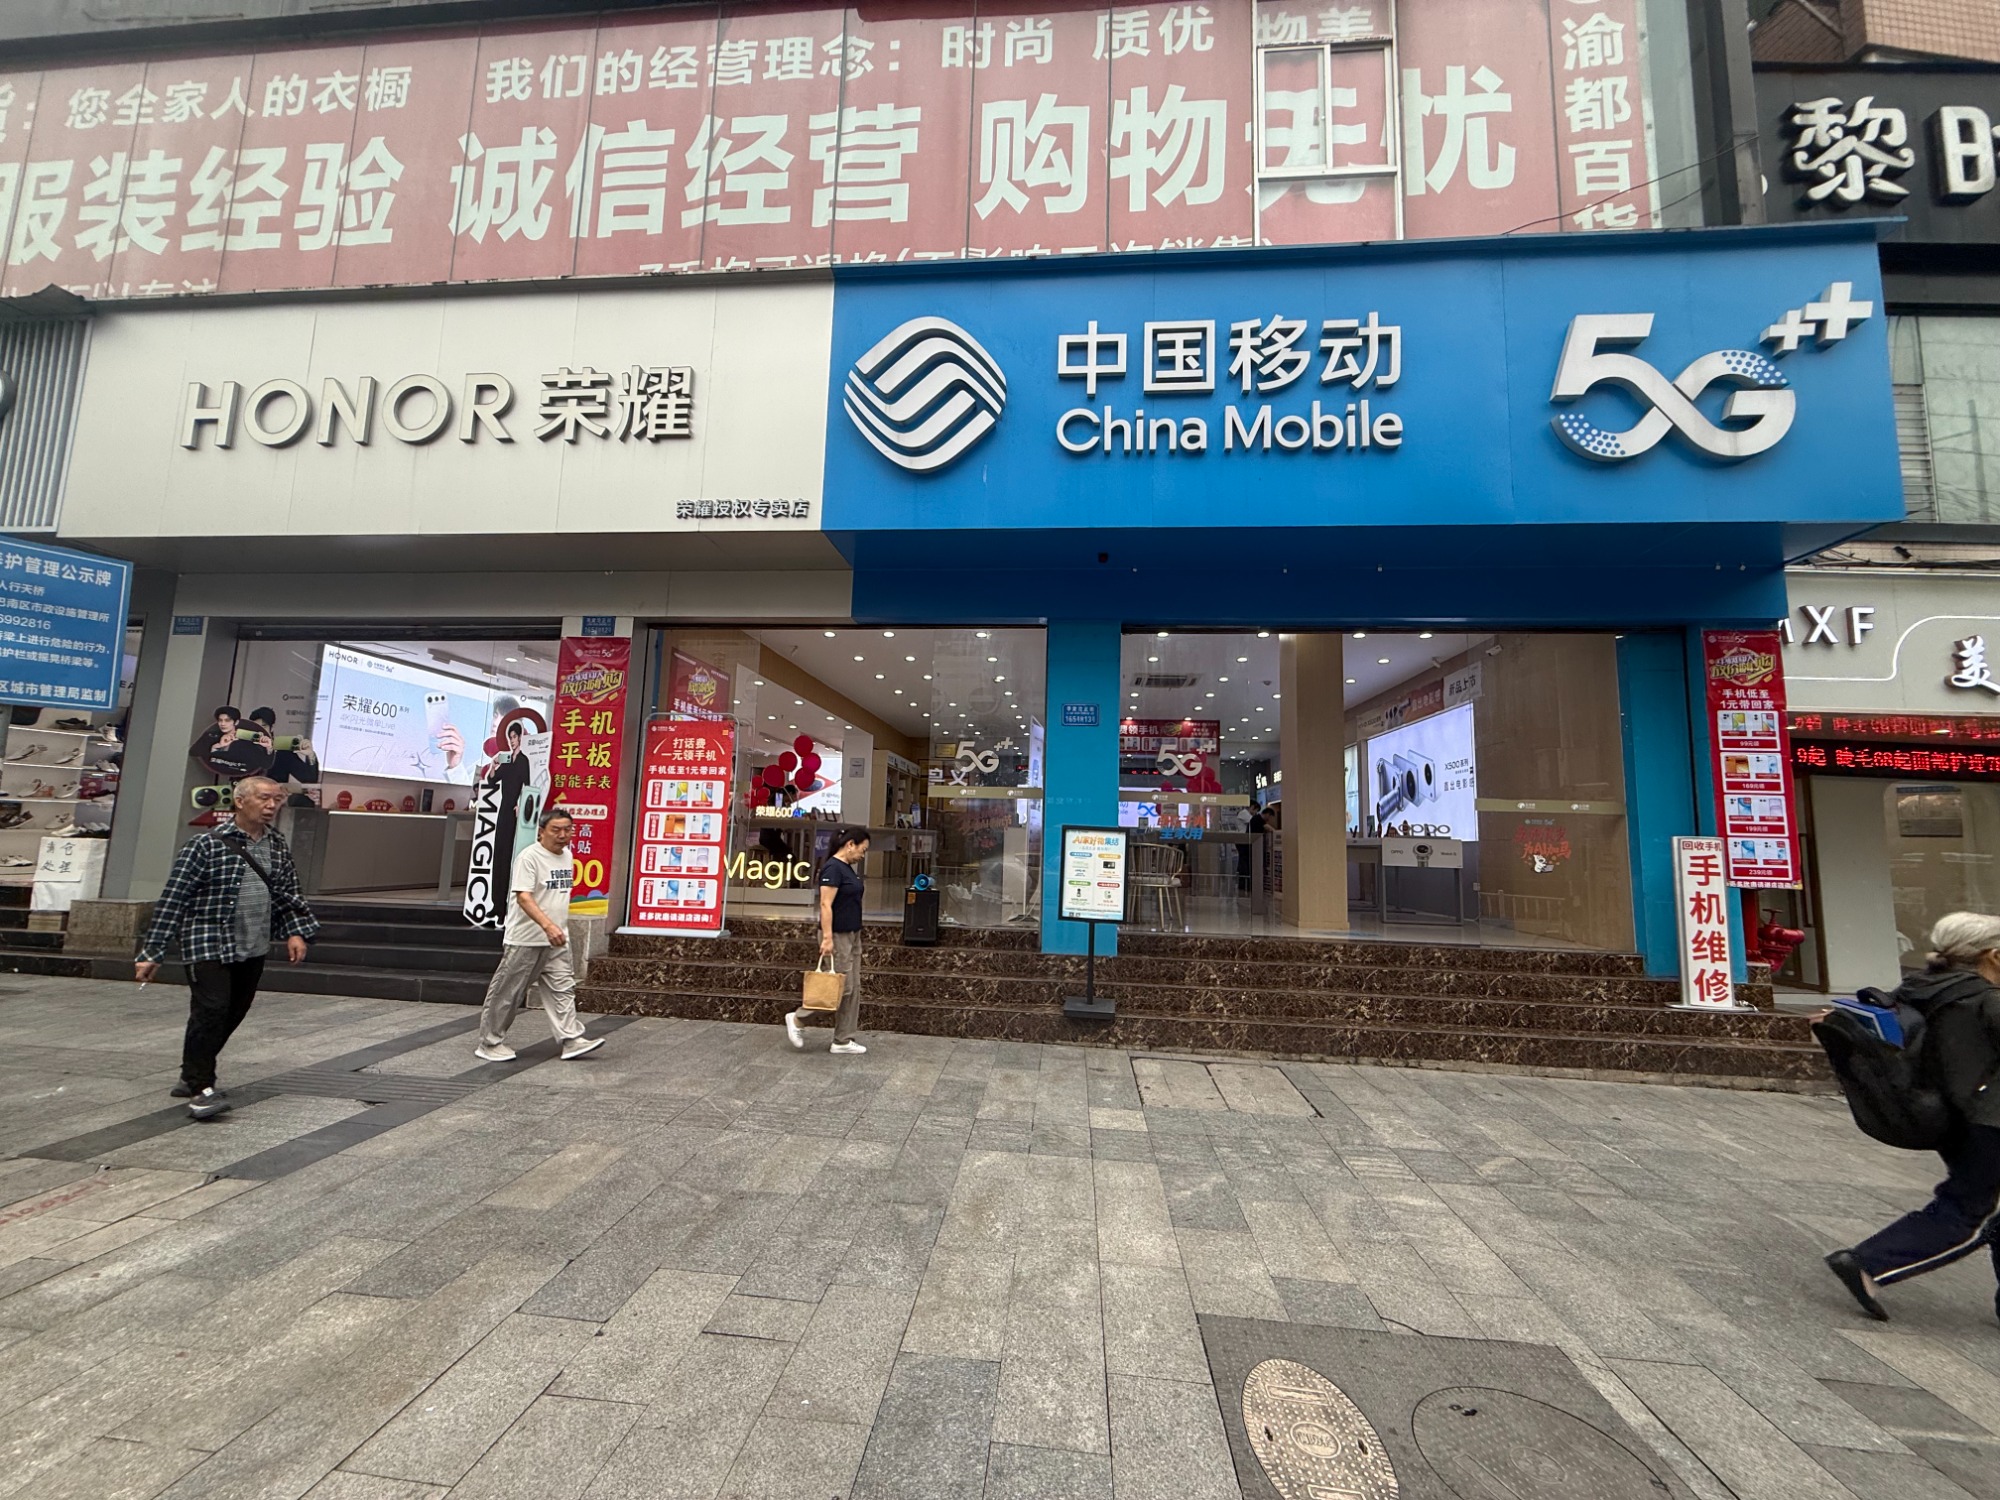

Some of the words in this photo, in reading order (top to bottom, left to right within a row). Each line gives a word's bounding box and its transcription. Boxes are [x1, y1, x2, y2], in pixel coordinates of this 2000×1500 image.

[941, 18, 1054, 69] 时尚
[1092, 5, 1214, 61] 质优
[448, 103, 922, 244] 诚信经营
[1057, 312, 1403, 400] 中国移动
[182, 371, 514, 450] HONOR
[533, 364, 695, 443] 荣耀
[1056, 404, 1209, 455] China
[1223, 399, 1405, 453] Mobile
[676, 498, 810, 519] 荣耀授权专卖店
[0, 552, 112, 588] 护管理公示牌
[329, 650, 358, 664] HONOR
[342, 694, 398, 718] 荣耀600
[1720, 699, 1775, 709] 1元带回家
[1722, 688, 1770, 699] 手机低至
[560, 708, 616, 735] 手机
[556, 741, 612, 768] 平板
[661, 750, 716, 761] 一元领手机
[673, 738, 706, 749] 打话费
[553, 773, 611, 789] 智能手表
[648, 765, 727, 775] 手机低至1元带回家
[463, 782, 501, 926] MAGIC9
[1682, 840, 1722, 851] 回收手机
[723, 851, 811, 889] Magic
[1687, 854, 1730, 1004] 手机维修
